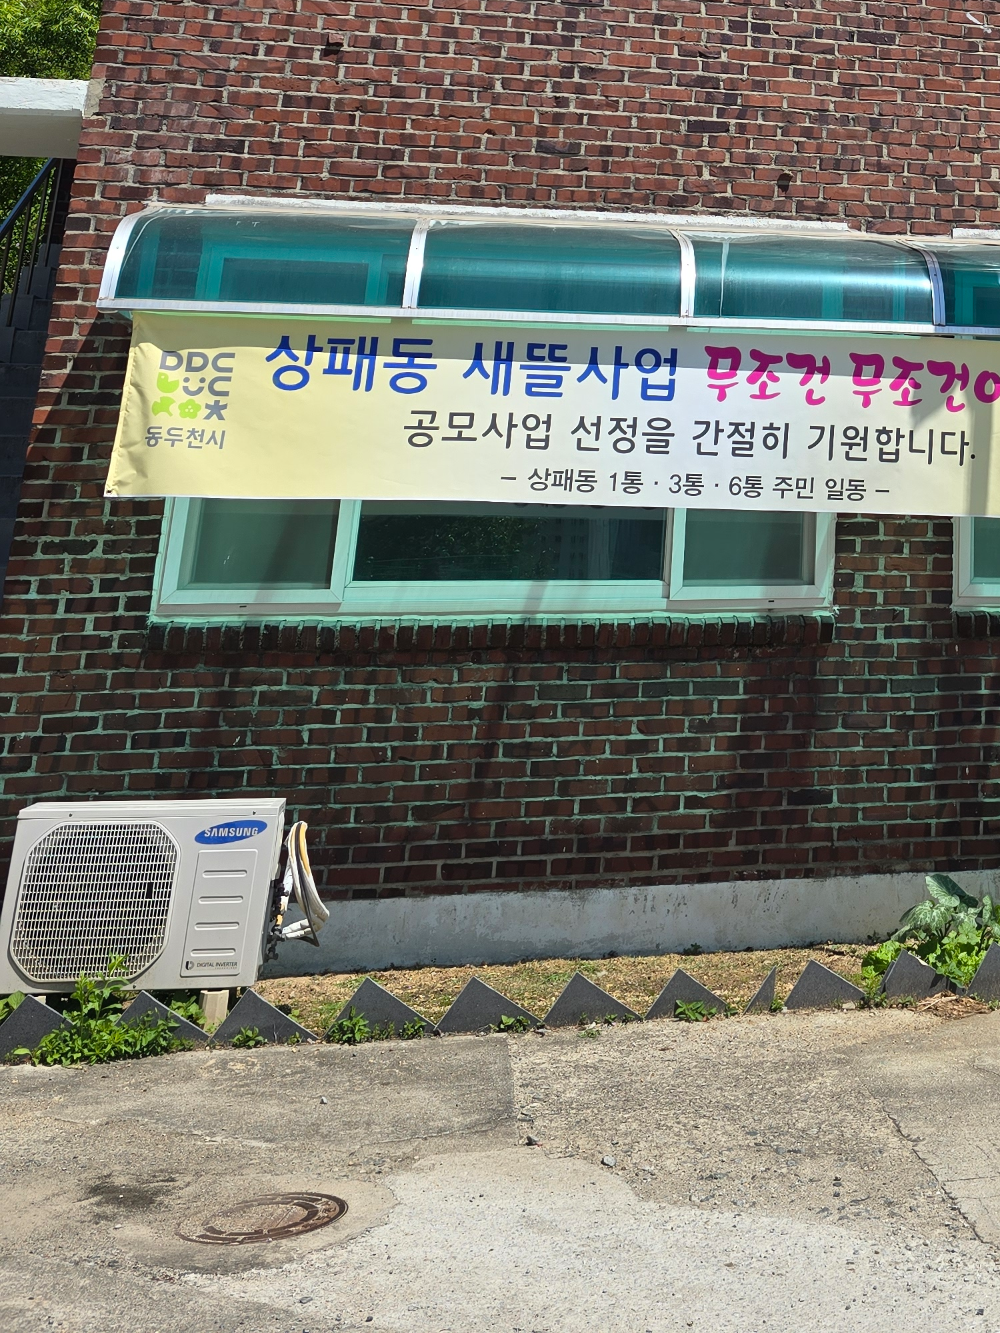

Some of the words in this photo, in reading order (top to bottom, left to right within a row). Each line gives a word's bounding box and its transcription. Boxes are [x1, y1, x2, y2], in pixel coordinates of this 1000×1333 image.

[159, 350, 236, 373] DDC
[266, 334, 437, 395] 상패동
[463, 341, 678, 402] 새뜰사업
[704, 345, 831, 406] 무조건
[145, 426, 226, 450] 동두천시
[403, 410, 552, 451] 공모사업
[570, 415, 676, 455] 선정을
[692, 419, 790, 460] 간절히
[807, 424, 976, 467] 기원합니다.
[527, 467, 598, 493] 상패동
[772, 476, 815, 500] 주민
[825, 478, 867, 502] 일동
[204, 827, 259, 837] SAMSUNG
